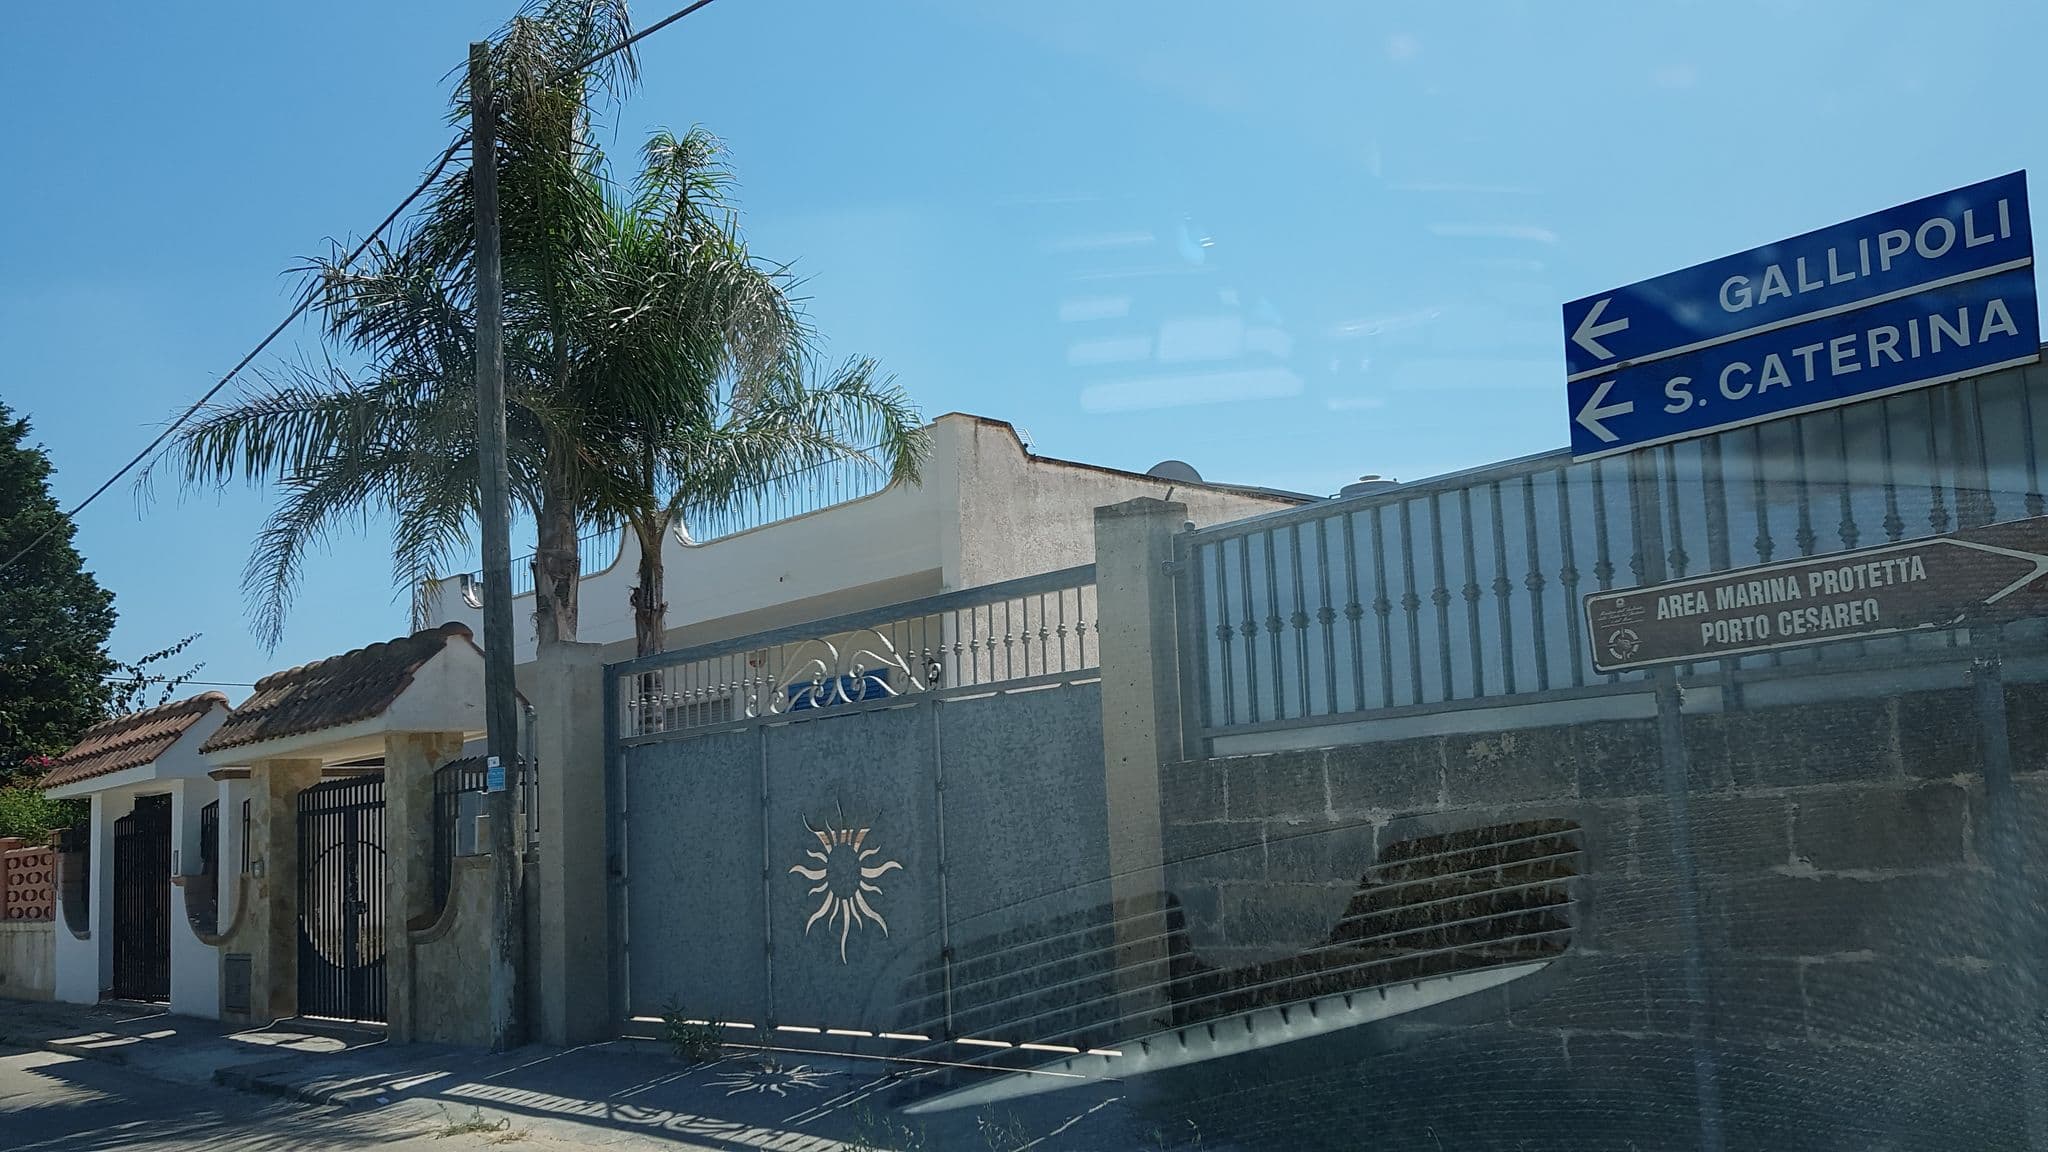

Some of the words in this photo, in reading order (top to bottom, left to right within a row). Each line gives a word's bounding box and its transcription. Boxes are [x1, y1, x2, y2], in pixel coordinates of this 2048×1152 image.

[1719, 199, 2011, 313] GALLIPOLI
[1664, 377, 1707, 414] S.
[1719, 298, 2018, 400] CATERINA
[1656, 591, 1709, 620] AREA
[1716, 576, 1801, 610] MARINA
[1808, 555, 1927, 598] PROTETTA
[1701, 614, 1771, 646] PORTO
[1778, 598, 1880, 636] CESAREO
